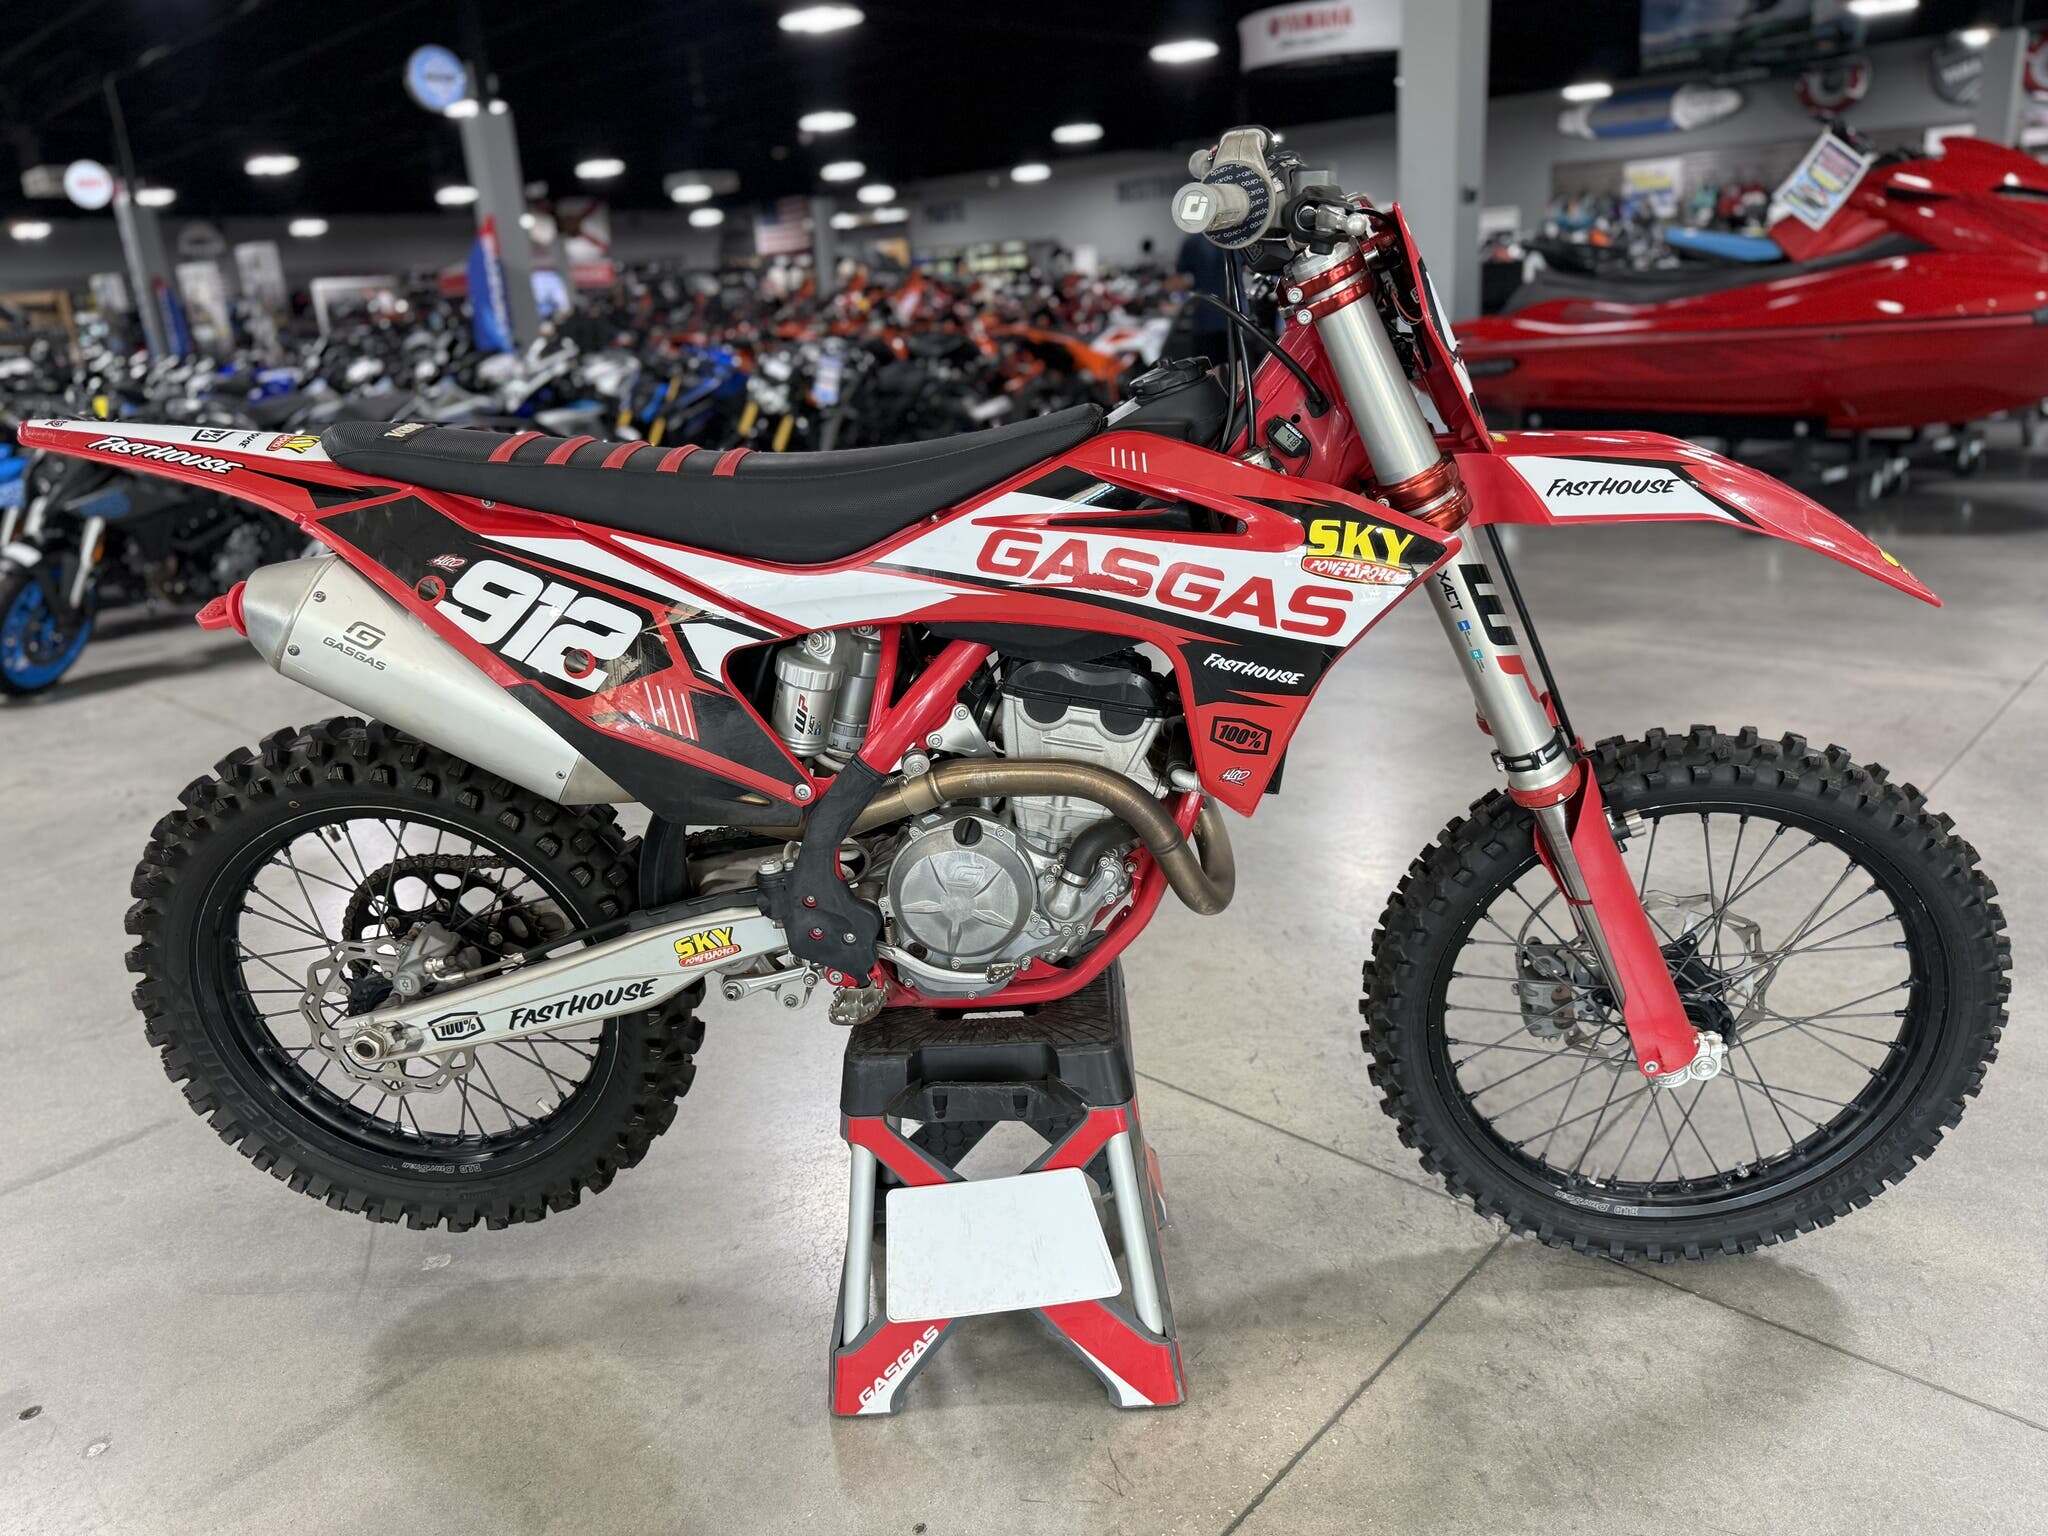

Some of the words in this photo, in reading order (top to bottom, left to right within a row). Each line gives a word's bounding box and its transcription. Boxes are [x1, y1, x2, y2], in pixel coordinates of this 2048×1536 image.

[88, 435, 245, 474] FASTHOUSE
[1545, 476, 1681, 498] FASTHOUSE
[1307, 519, 1415, 567] SKY
[976, 529, 1353, 637] GASGAS
[1436, 570, 1464, 611] XACT
[434, 559, 643, 693] 912
[322, 636, 387, 671] GASGAS
[1203, 653, 1305, 685] FASTHOUSE
[1218, 724, 1264, 749] 100%
[674, 926, 734, 960] SKY
[508, 978, 660, 1031] FASTHOUSE
[438, 1018, 478, 1038] 100%
[858, 1325, 940, 1407] GASGAS
